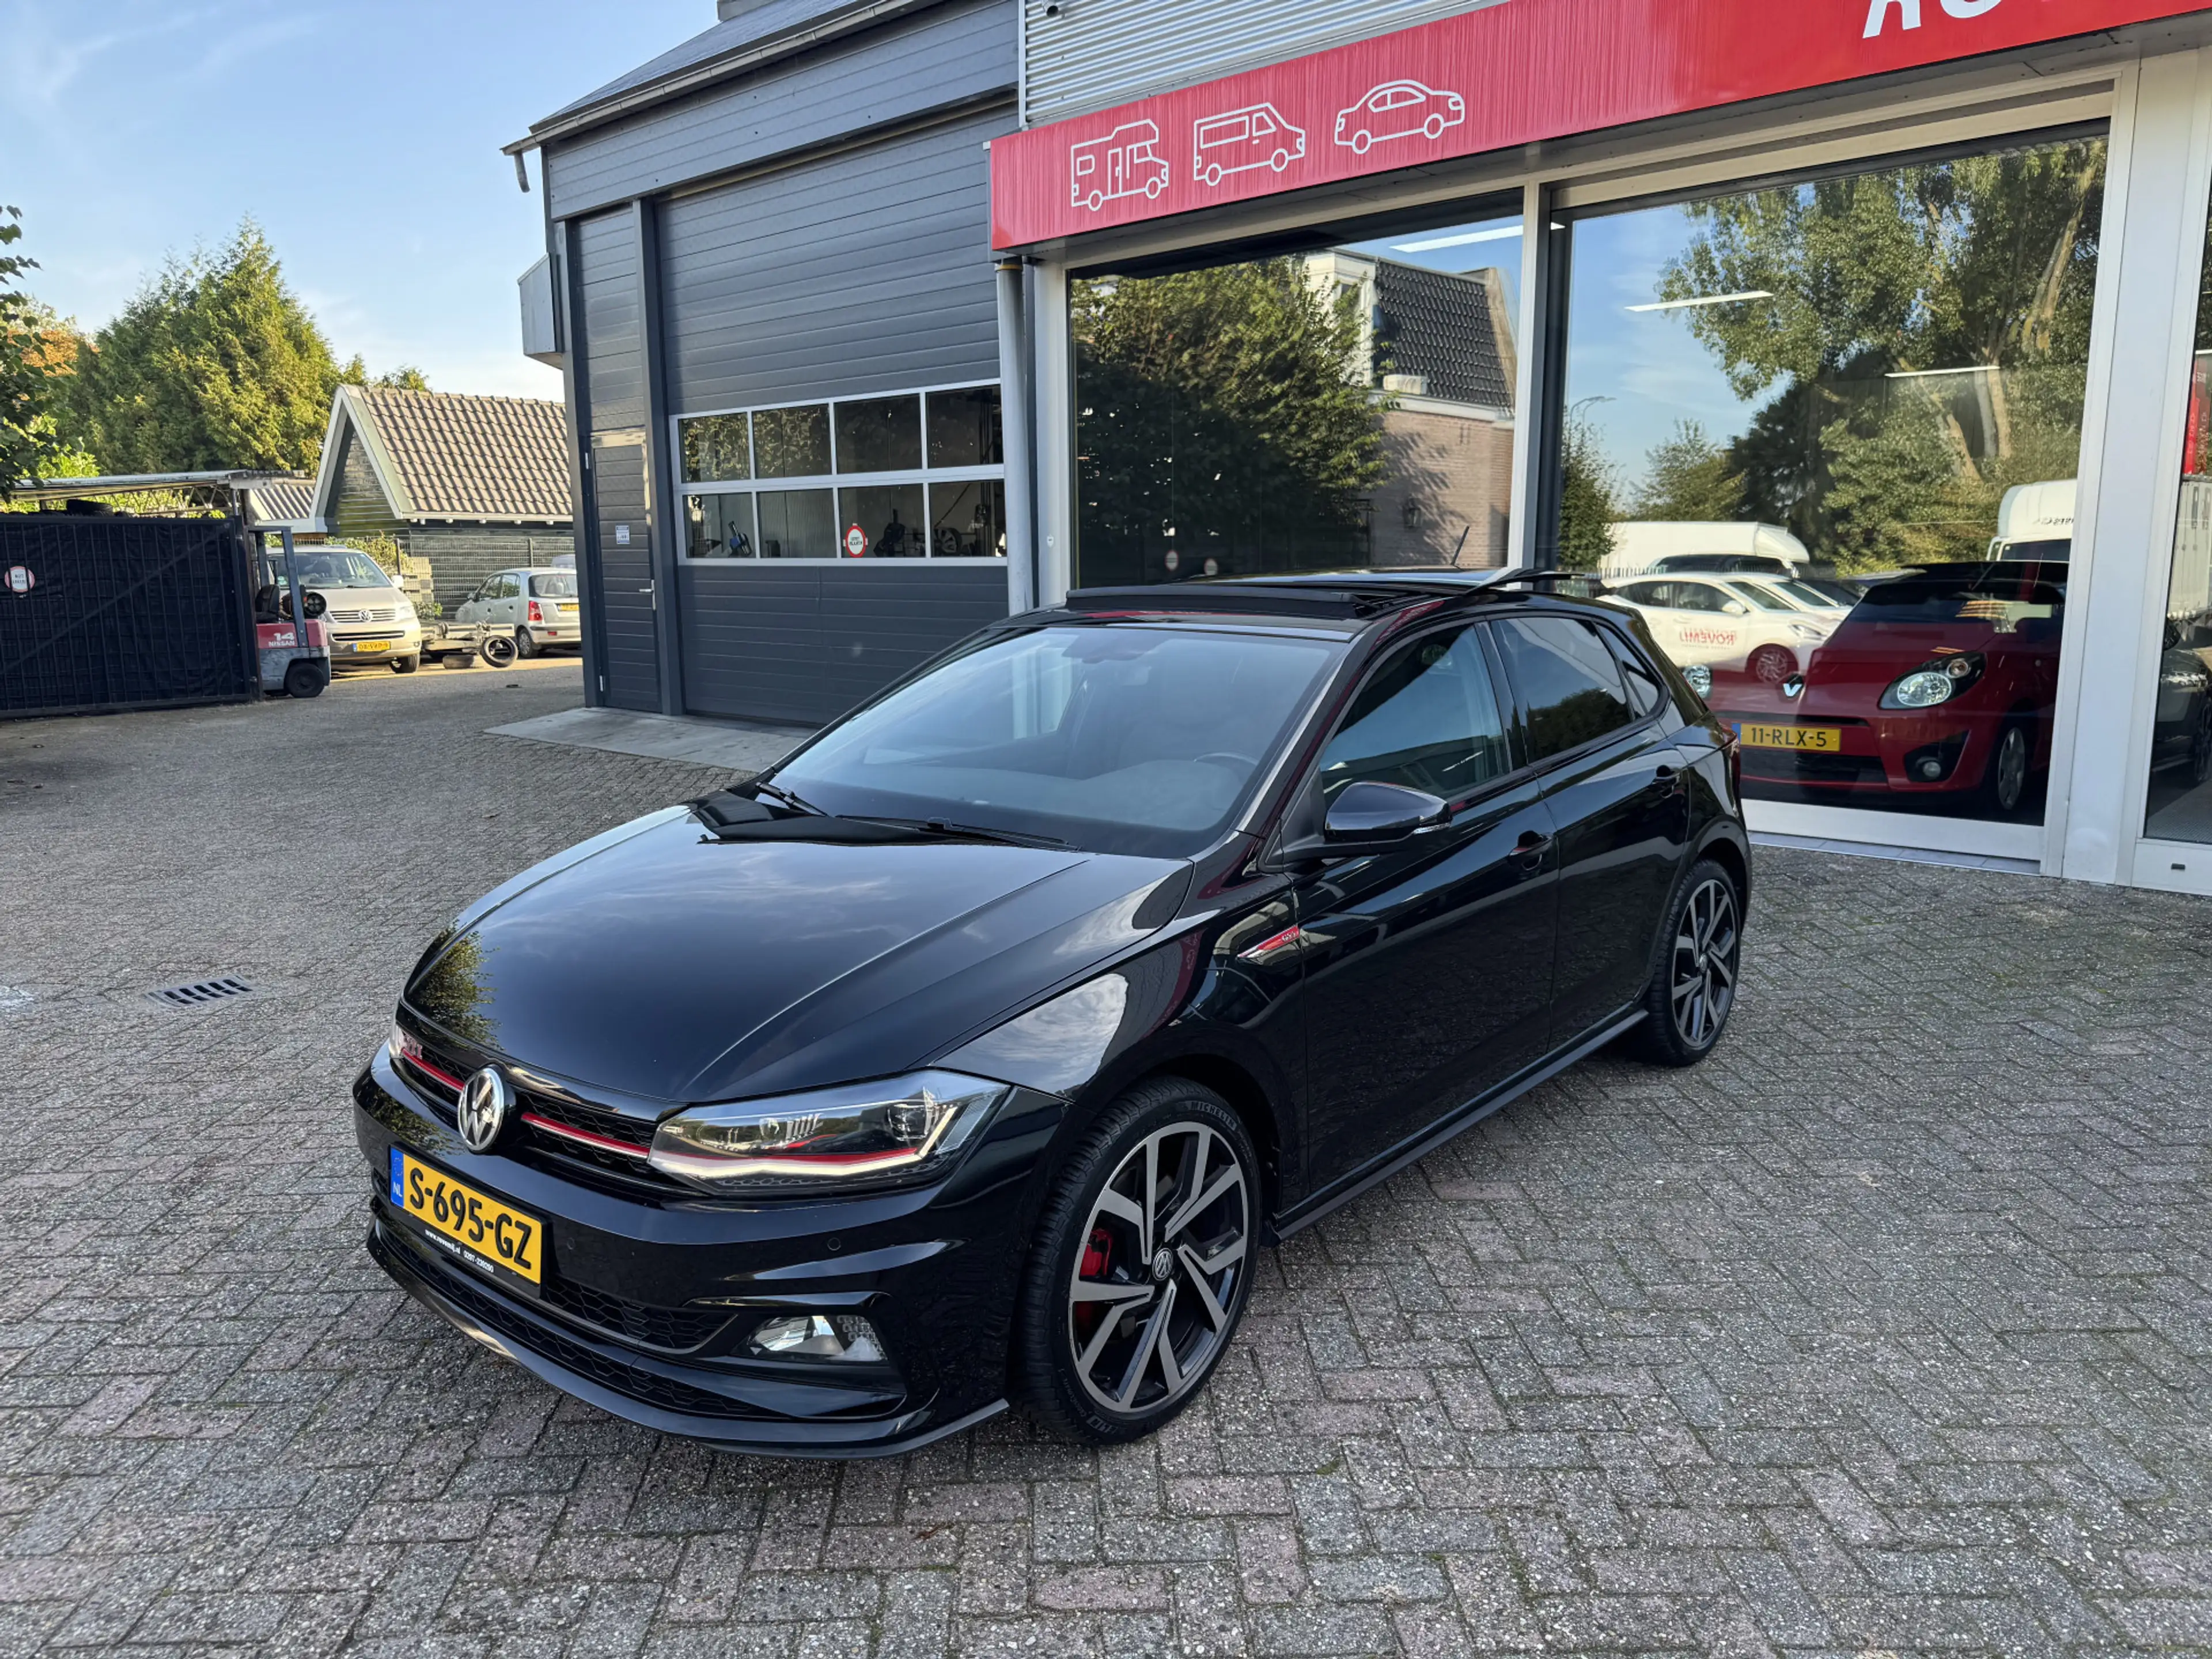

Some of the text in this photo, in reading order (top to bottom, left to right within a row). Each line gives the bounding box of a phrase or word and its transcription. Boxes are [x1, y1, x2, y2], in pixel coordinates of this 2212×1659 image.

[274, 632, 294, 641] 14
[1751, 727, 1827, 747] 11-RLX-5
[1188, 1100, 1237, 1130] MICHELIN
[393, 1181, 403, 1198] NL
[410, 1167, 532, 1270] S-695-GZ
